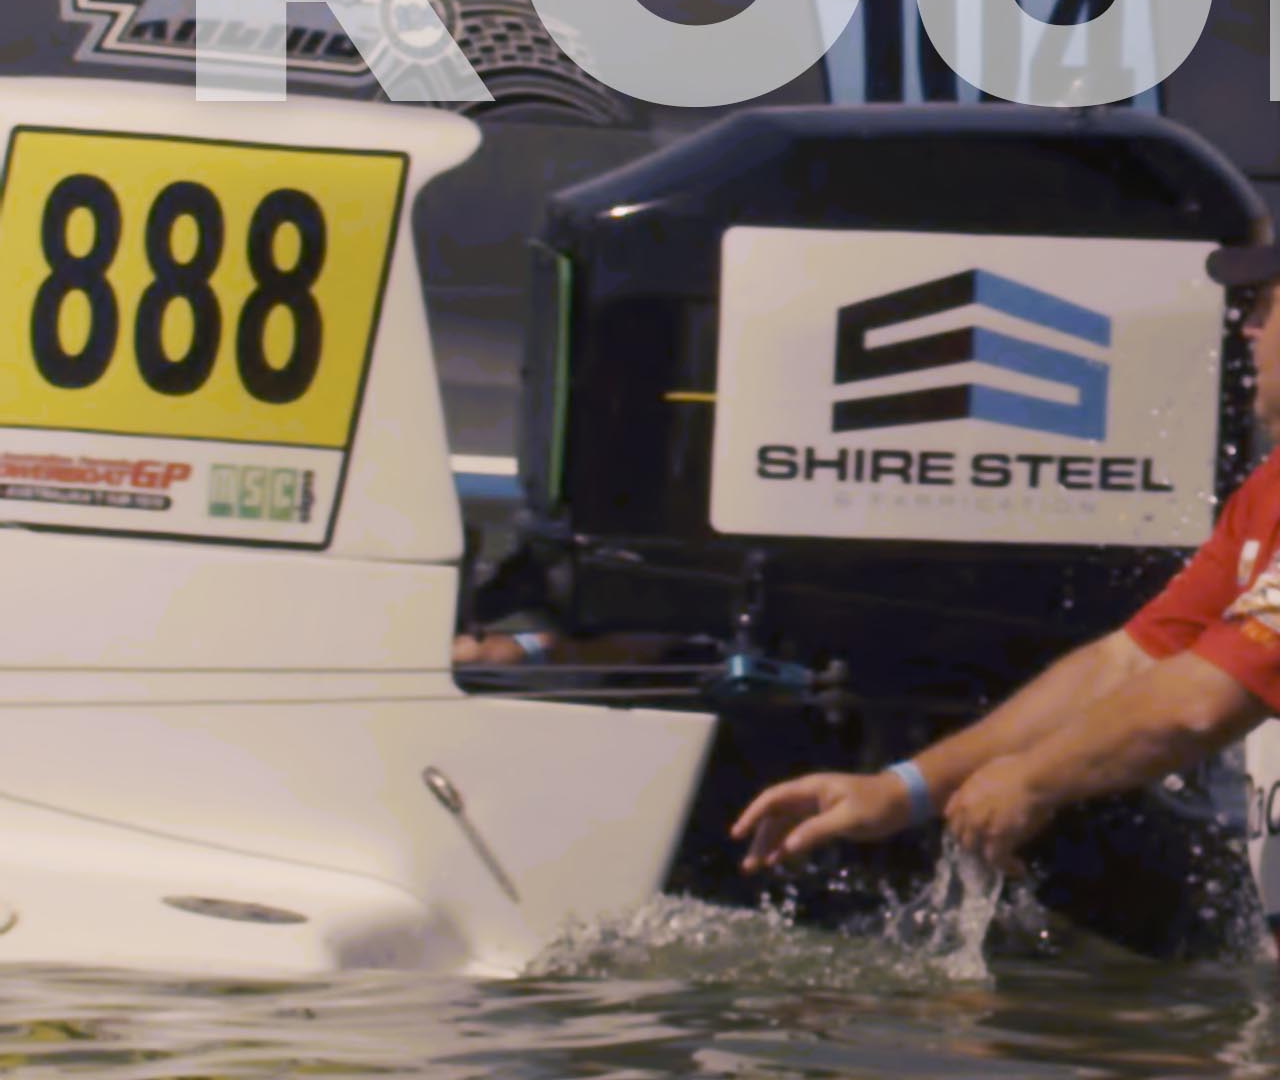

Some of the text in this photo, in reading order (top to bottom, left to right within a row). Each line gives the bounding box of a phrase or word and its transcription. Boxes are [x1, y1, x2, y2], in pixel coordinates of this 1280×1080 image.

[30, 173, 328, 404] 888
[756, 445, 1175, 494] SHIRE STEEL
